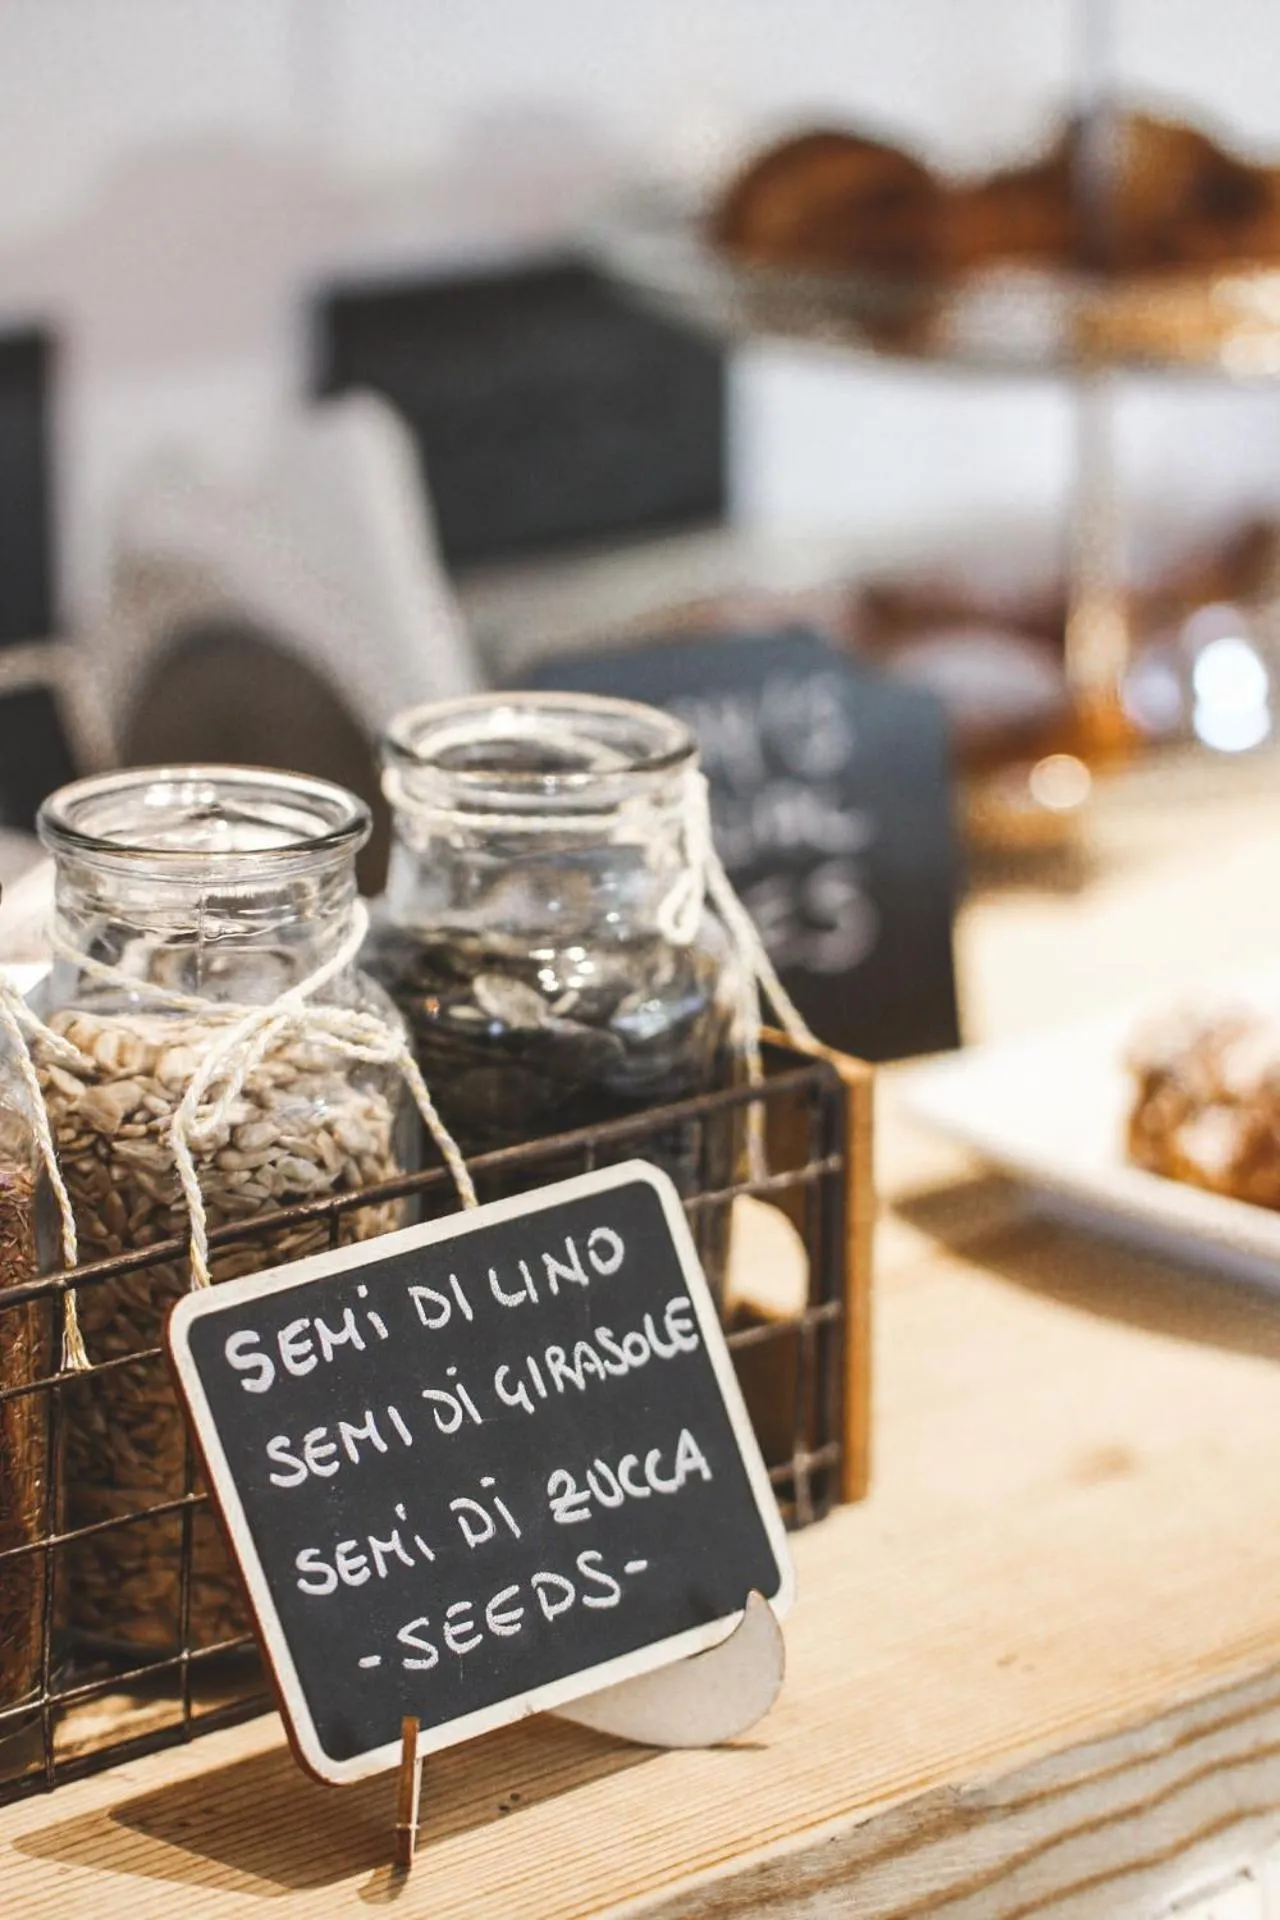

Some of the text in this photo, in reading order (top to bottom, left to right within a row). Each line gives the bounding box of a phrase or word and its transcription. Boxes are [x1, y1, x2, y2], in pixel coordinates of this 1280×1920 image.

[407, 1273, 474, 1330] DI
[488, 1226, 625, 1308] LINO
[266, 1405, 413, 1488] SEMI
[494, 1296, 699, 1415] GIRASOLE
[546, 1428, 713, 1524] ZUCCA
